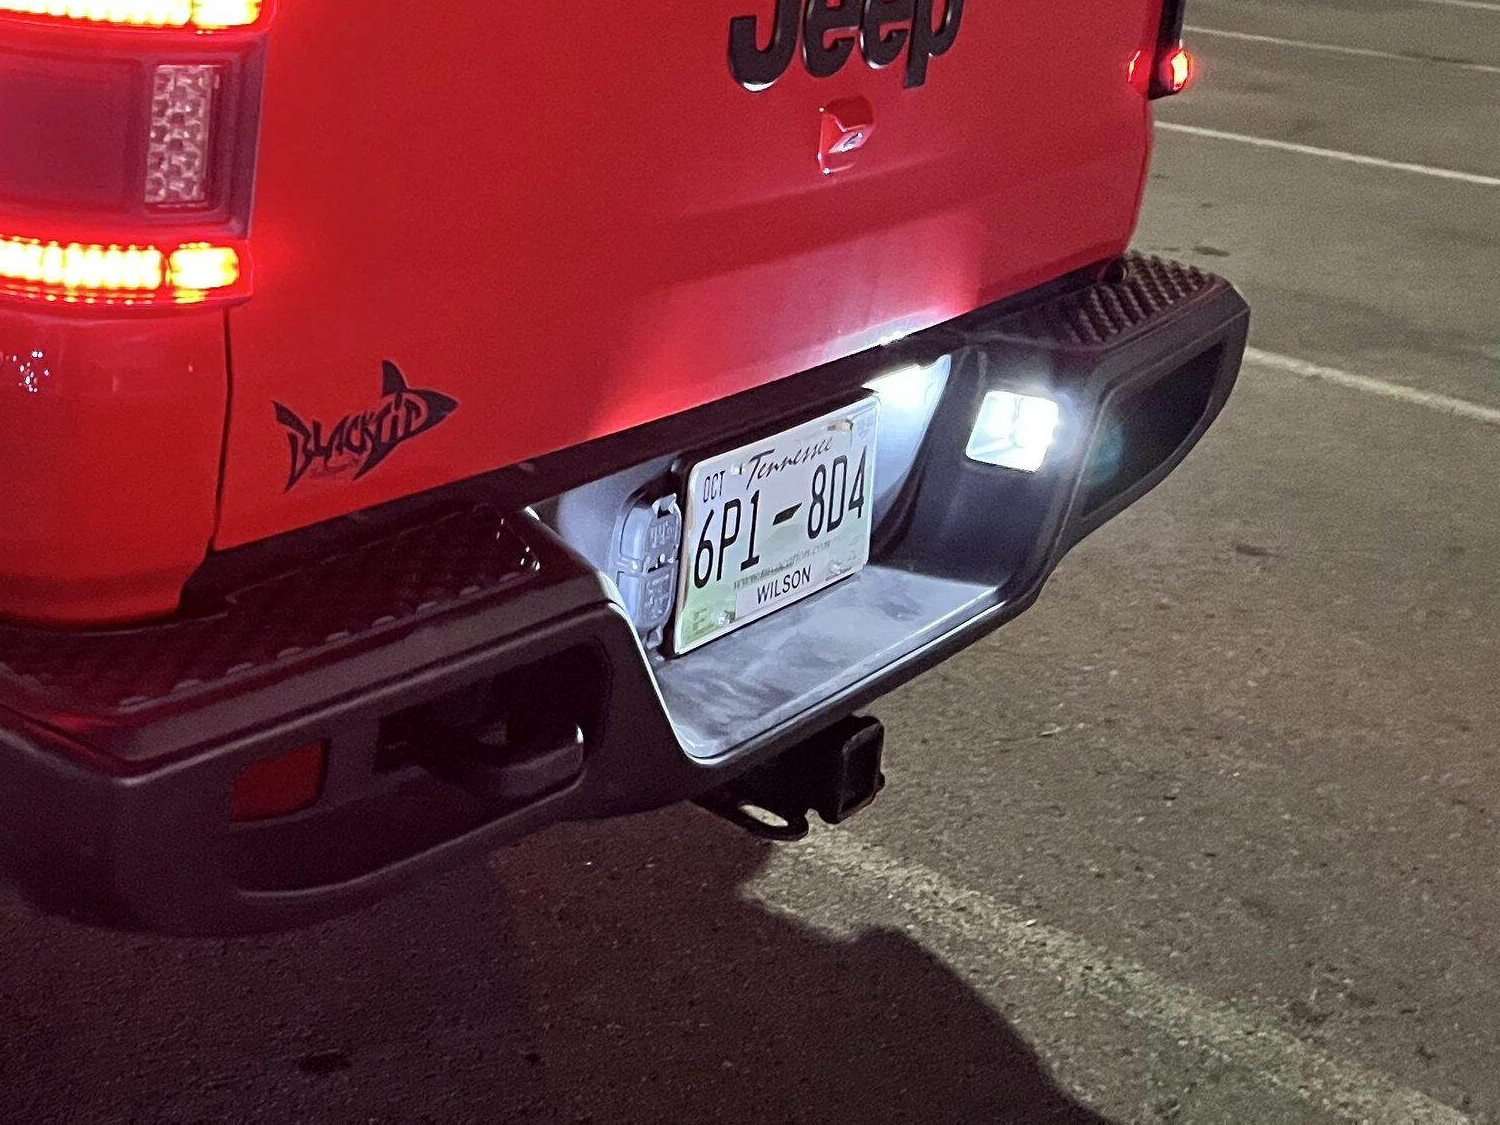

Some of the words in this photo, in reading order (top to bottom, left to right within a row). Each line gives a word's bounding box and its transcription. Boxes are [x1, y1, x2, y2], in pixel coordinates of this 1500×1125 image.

[744, 436, 834, 490] Tennessee
[702, 469, 726, 504] OCT
[757, 564, 812, 605] WILSON
